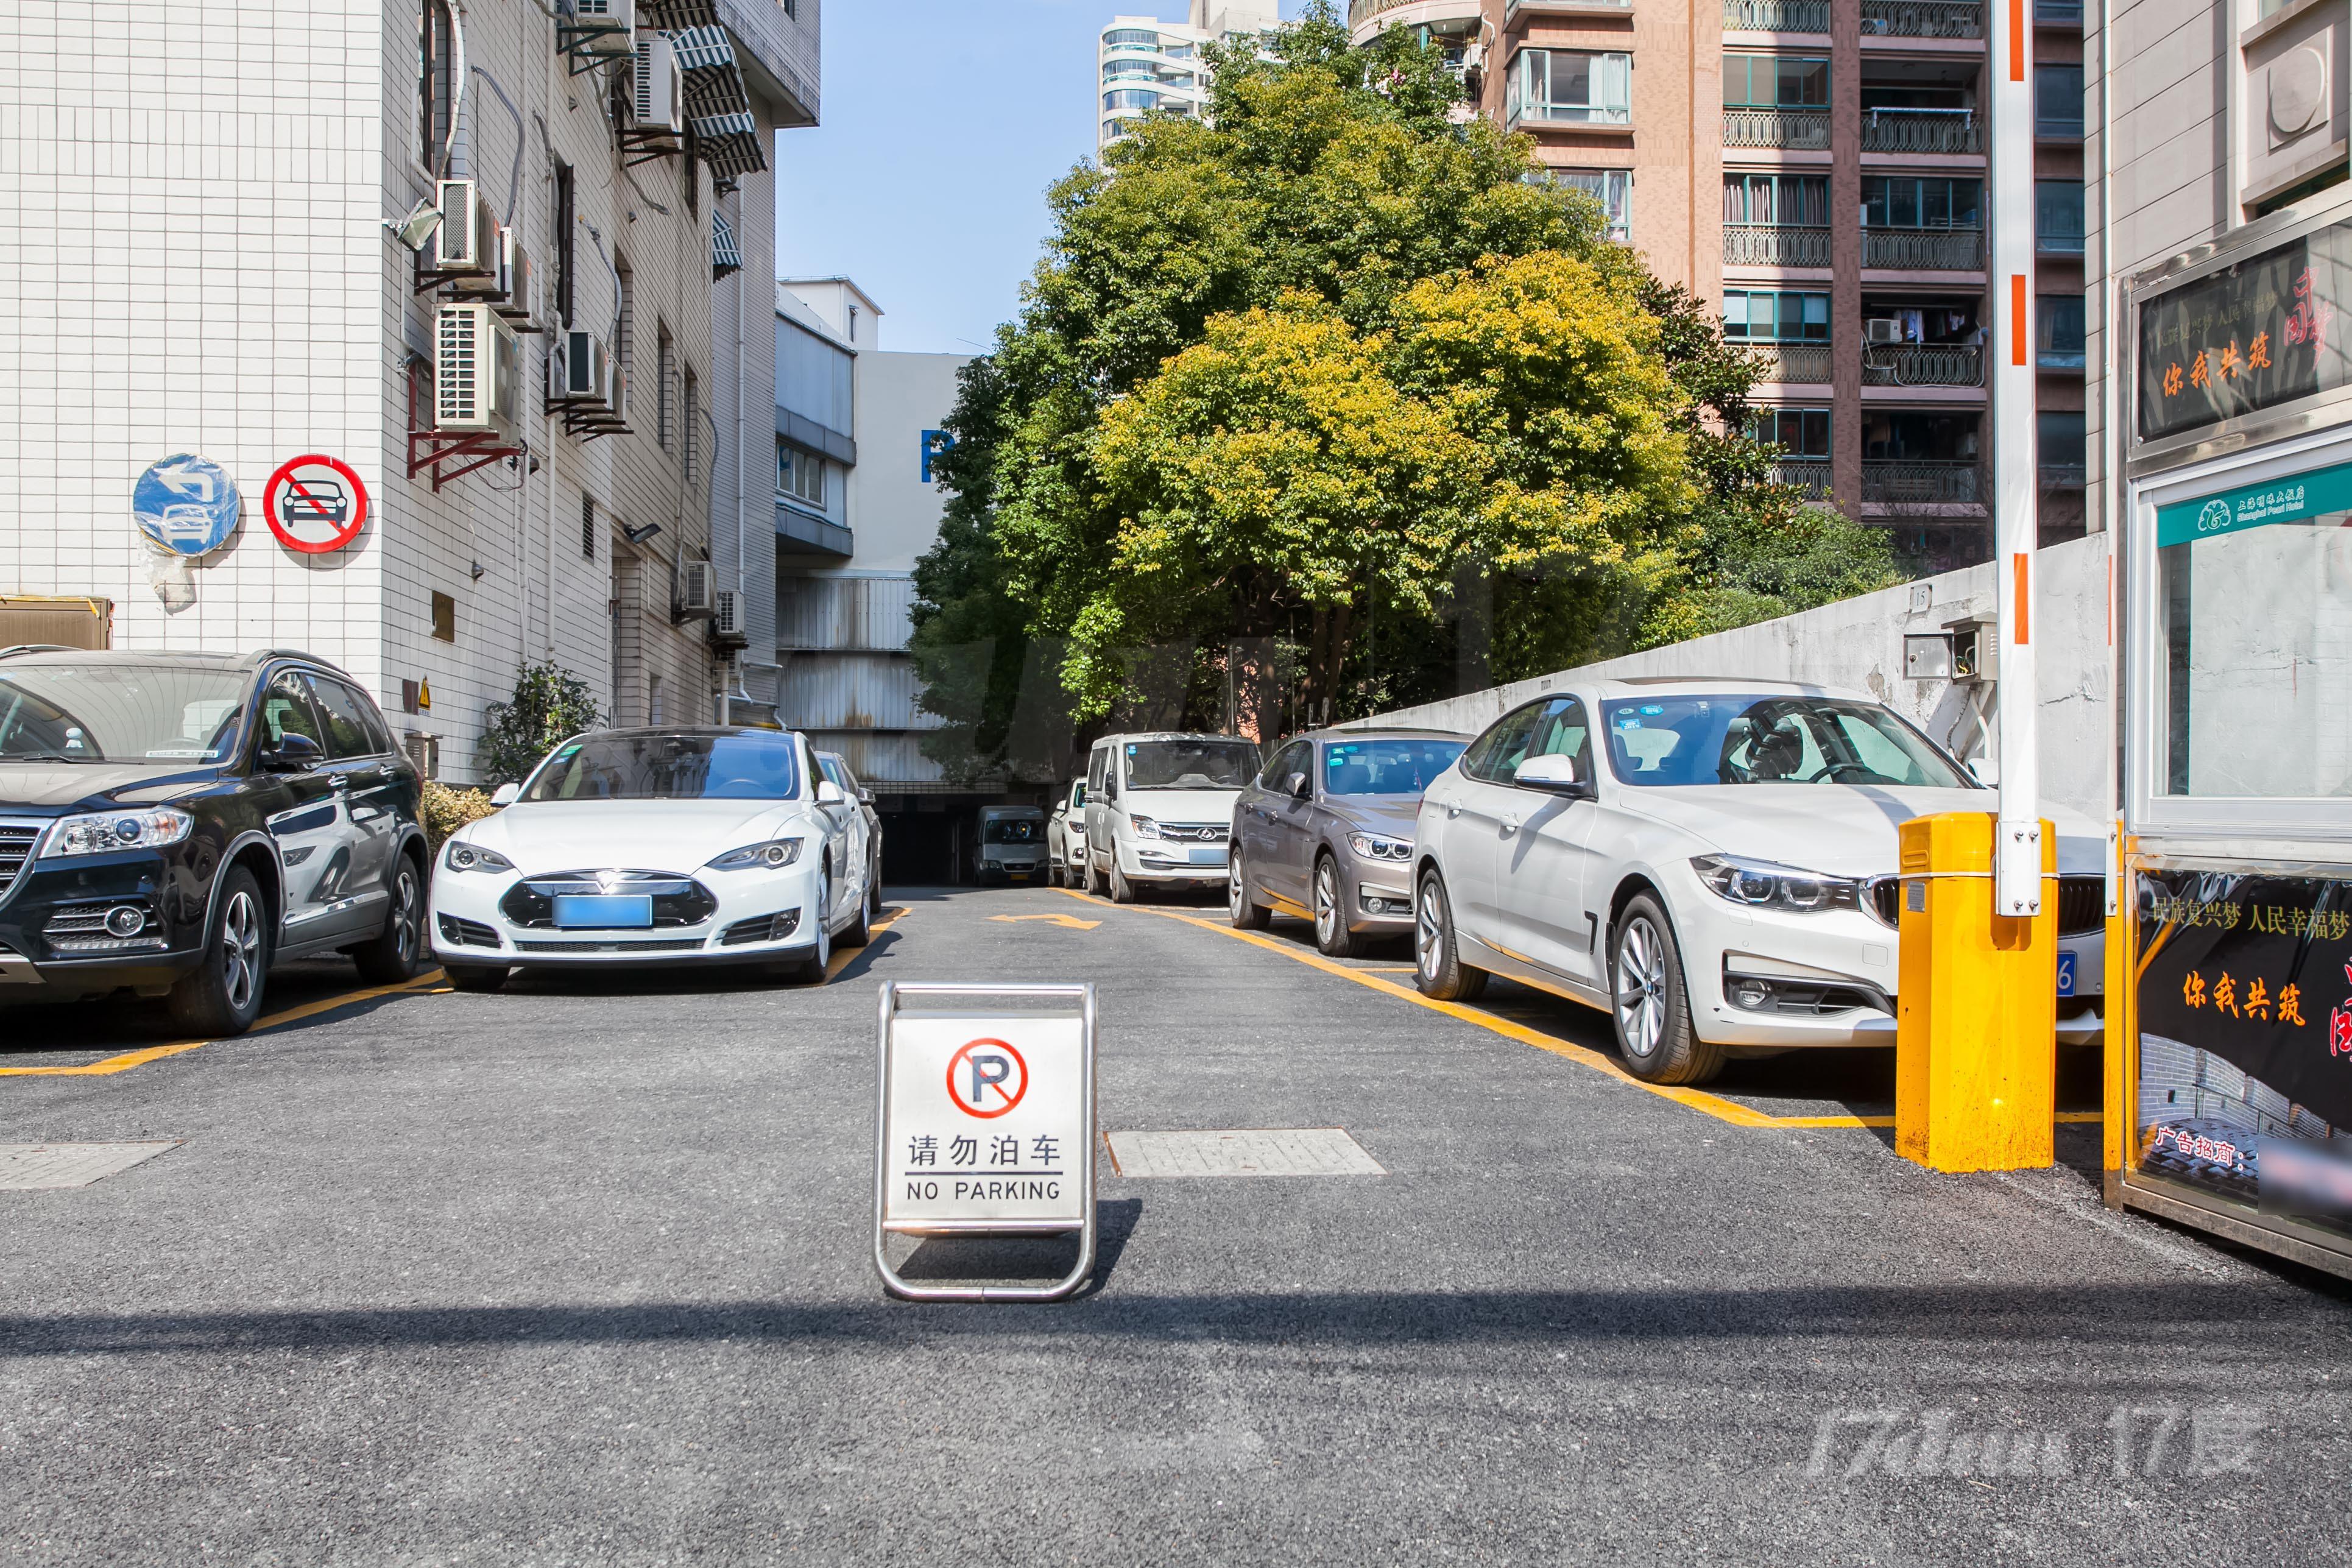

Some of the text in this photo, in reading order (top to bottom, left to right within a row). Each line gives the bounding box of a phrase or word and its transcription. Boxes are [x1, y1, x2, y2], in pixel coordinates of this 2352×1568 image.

[2163, 331, 2272, 398] 你我共筑
[2237, 486, 2304, 511] 上海明珠大饭店
[2237, 500, 2304, 522] Shanghai Pearl Hotel
[1916, 590, 1926, 606] 15
[2152, 897, 2351, 940] 民族复兴梦 人民幸福梦
[2183, 970, 2306, 1027] 你我共筑
[908, 1135, 1061, 1166] 请勿泊车
[907, 1182, 1061, 1200] NO PARKING
